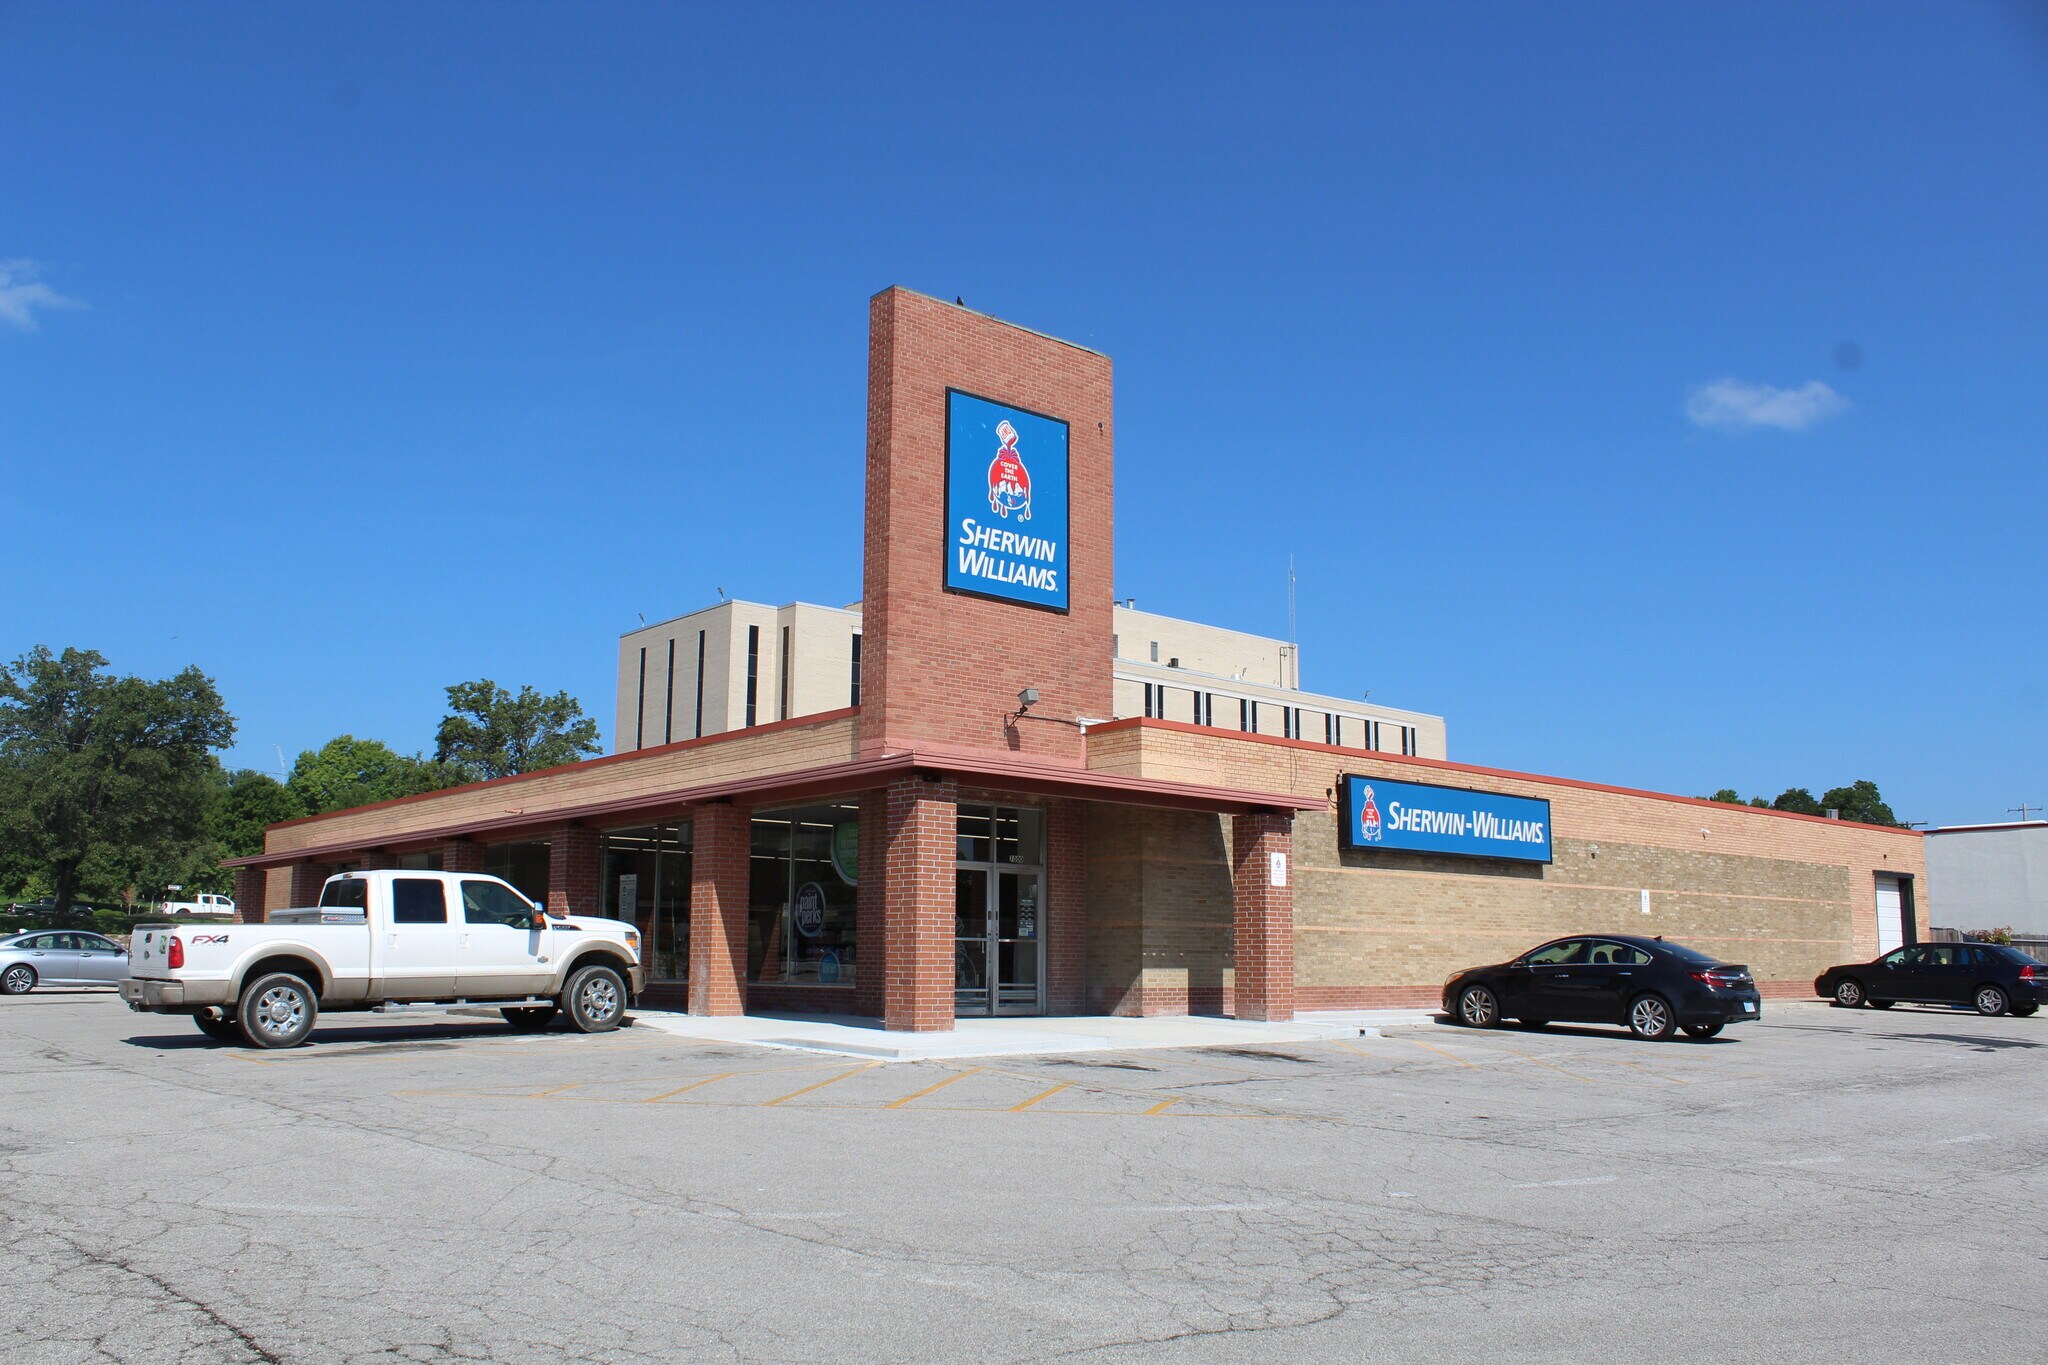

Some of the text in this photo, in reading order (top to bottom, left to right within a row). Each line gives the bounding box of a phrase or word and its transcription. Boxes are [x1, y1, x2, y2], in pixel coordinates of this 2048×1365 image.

[1000, 460, 1018, 470] COVER
[1004, 467, 1015, 476] THE
[1000, 473, 1018, 482] EARTH
[959, 518, 1056, 563] SHERWIN
[958, 546, 1057, 592] WILLIAMS
[1387, 801, 1544, 844] SHERWIN-WILLIAMS
[799, 893, 818, 913] paint
[801, 909, 822, 927] perks
[191, 934, 229, 944] FX4
